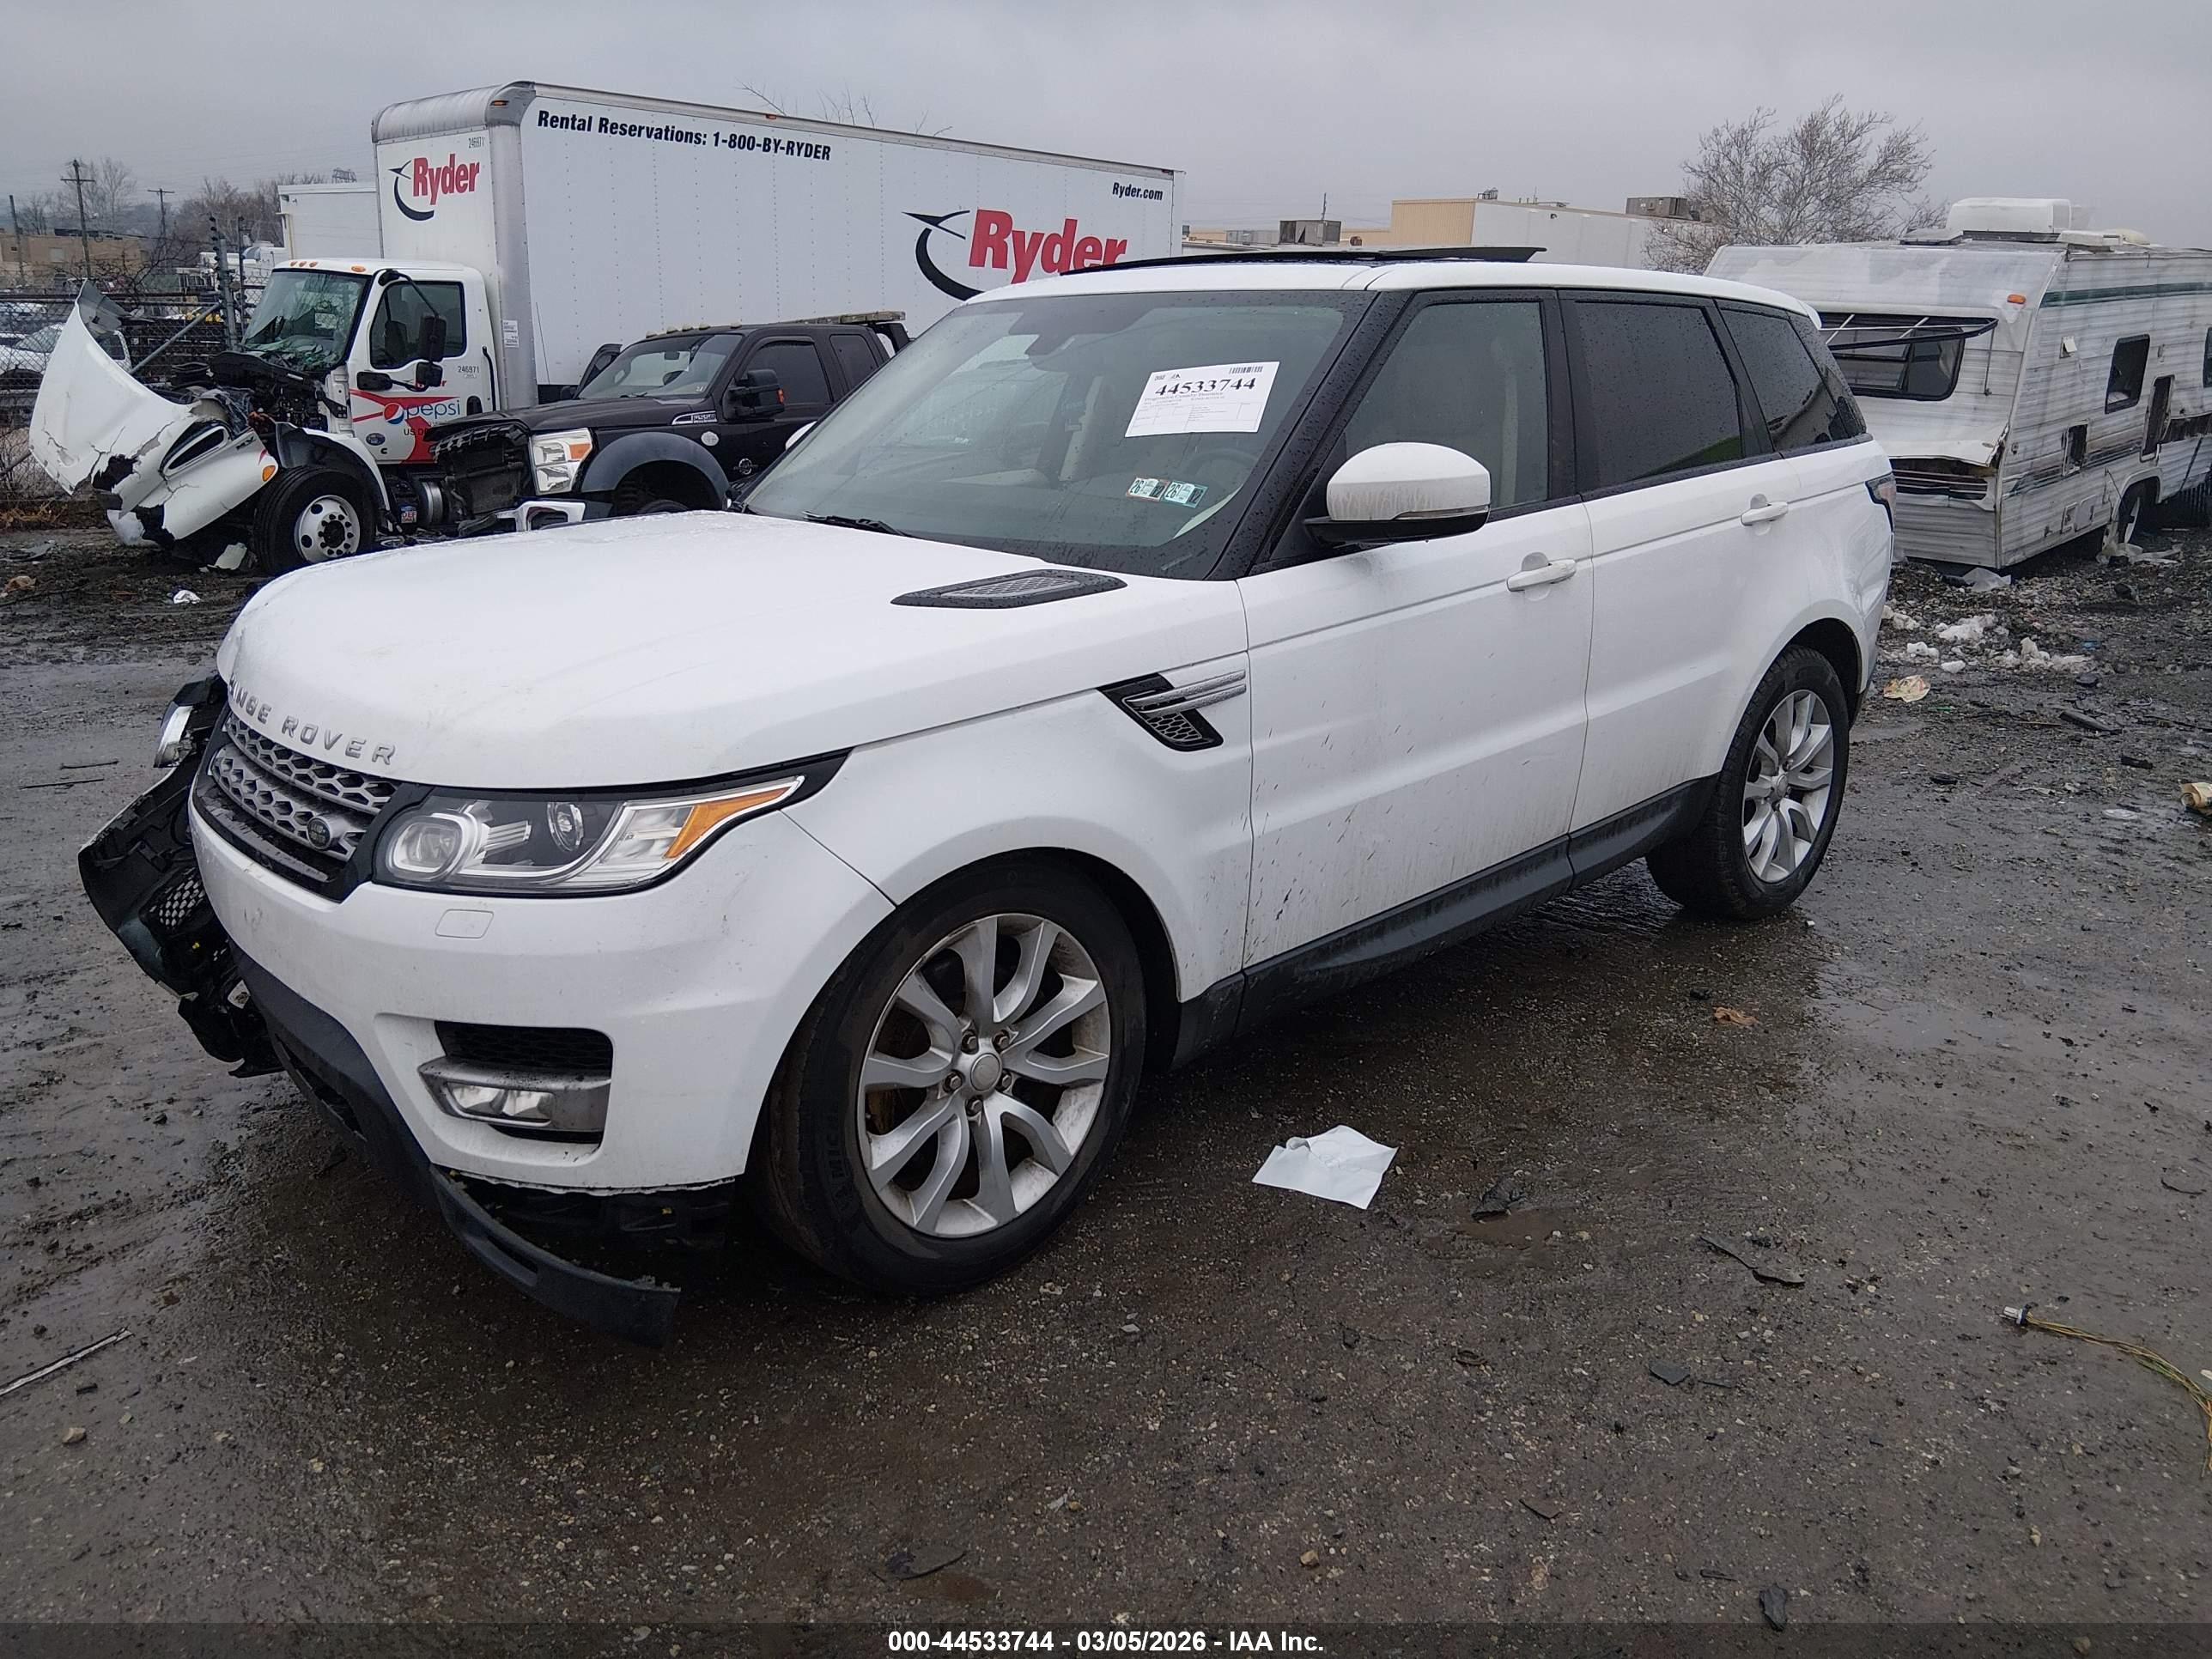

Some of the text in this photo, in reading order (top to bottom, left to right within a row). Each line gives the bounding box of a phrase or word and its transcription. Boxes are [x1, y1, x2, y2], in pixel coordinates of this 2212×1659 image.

[538, 110, 831, 161] Rental Reservations: 1-800-BY-RYDER
[413, 153, 479, 205] Ryder
[1113, 182, 1163, 201] Ryder.com
[969, 209, 1127, 284] Ryder
[407, 399, 460, 419] pepsi
[1155, 378, 1255, 395] 44533744
[282, 715, 396, 765] ROVER
